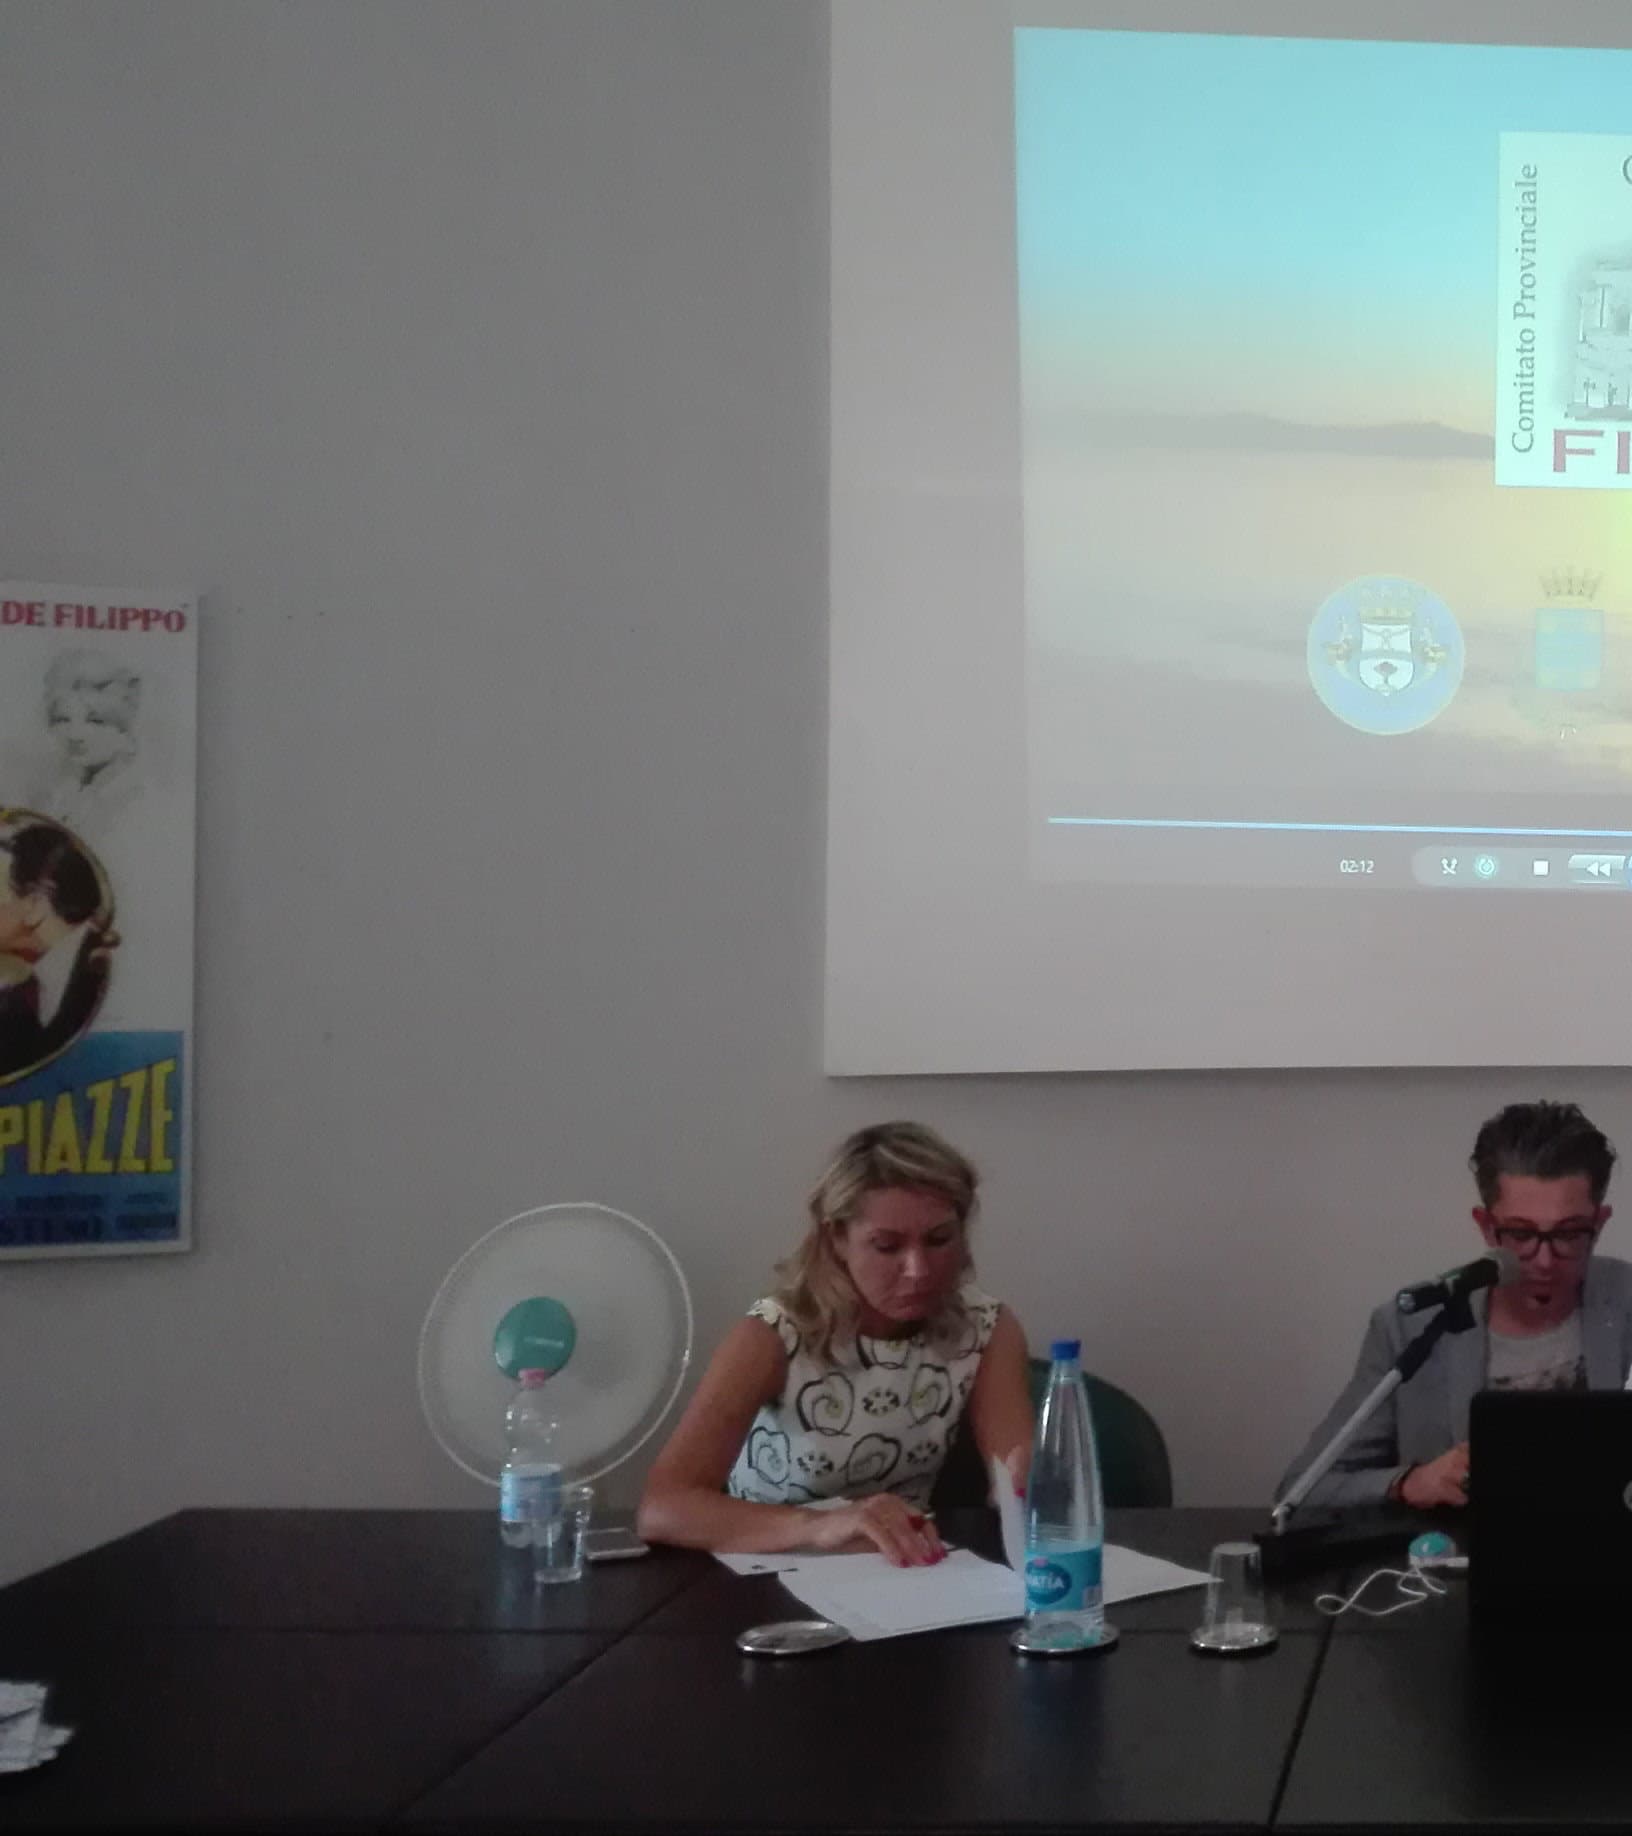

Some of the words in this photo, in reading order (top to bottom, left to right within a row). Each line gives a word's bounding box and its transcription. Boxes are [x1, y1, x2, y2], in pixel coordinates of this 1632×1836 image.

[1513, 163, 1539, 320] Provinciale
[1511, 326, 1536, 454] Comitato
[0, 600, 46, 627] DE
[54, 602, 188, 633] FILIPPO
[0, 1057, 177, 1176] PIAZZE
